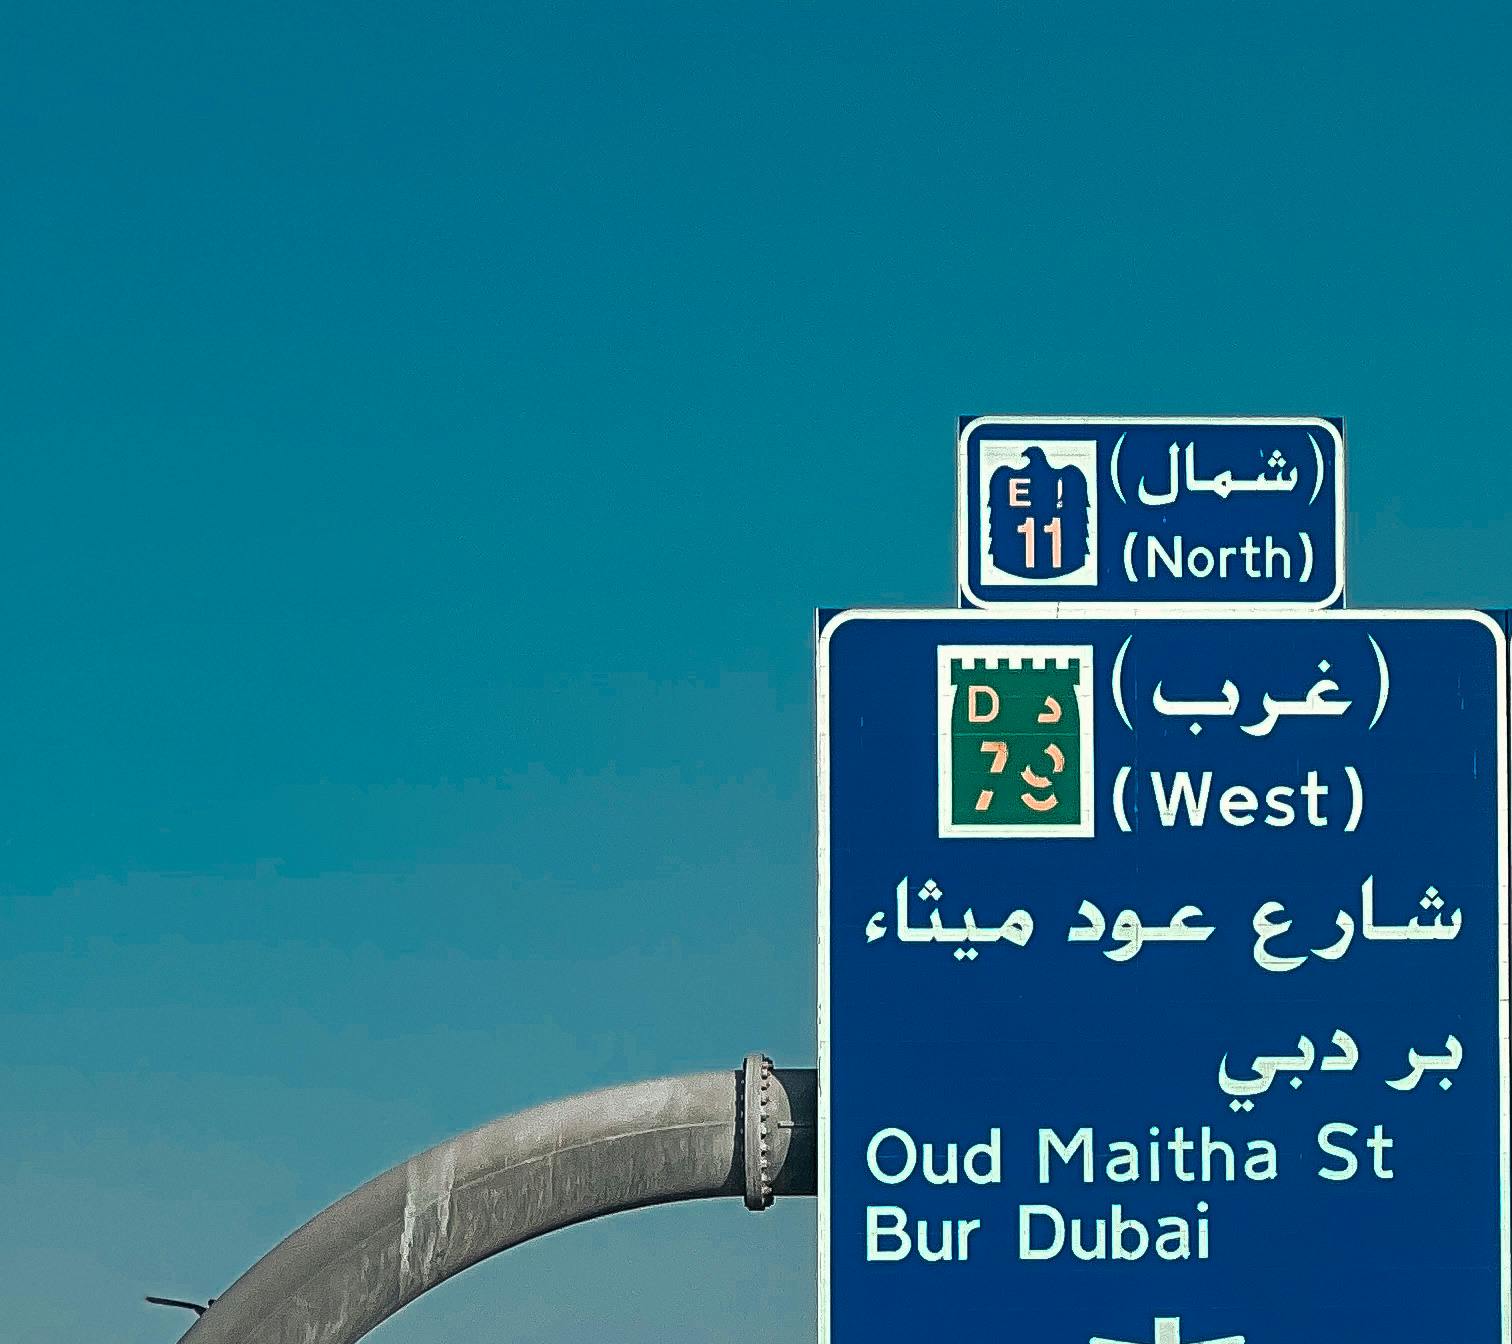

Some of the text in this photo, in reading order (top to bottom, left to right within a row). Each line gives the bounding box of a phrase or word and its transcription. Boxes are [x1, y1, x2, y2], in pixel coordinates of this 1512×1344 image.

[1009, 478, 1031, 507] E
[1109, 432, 1325, 506] (شمال)
[1017, 517, 1061, 568] 11
[1123, 532, 1314, 583] (North)
[968, 685, 1000, 722] D
[1112, 634, 1390, 736] (غرب)
[1112, 765, 1364, 832] (West)
[865, 875, 1463, 972] شارع عود ميثاء
[1217, 1028, 1463, 1114] بر دبي
[865, 1121, 1395, 1185] Oud Maitha St
[865, 1201, 1210, 1262] Bur Dubai
